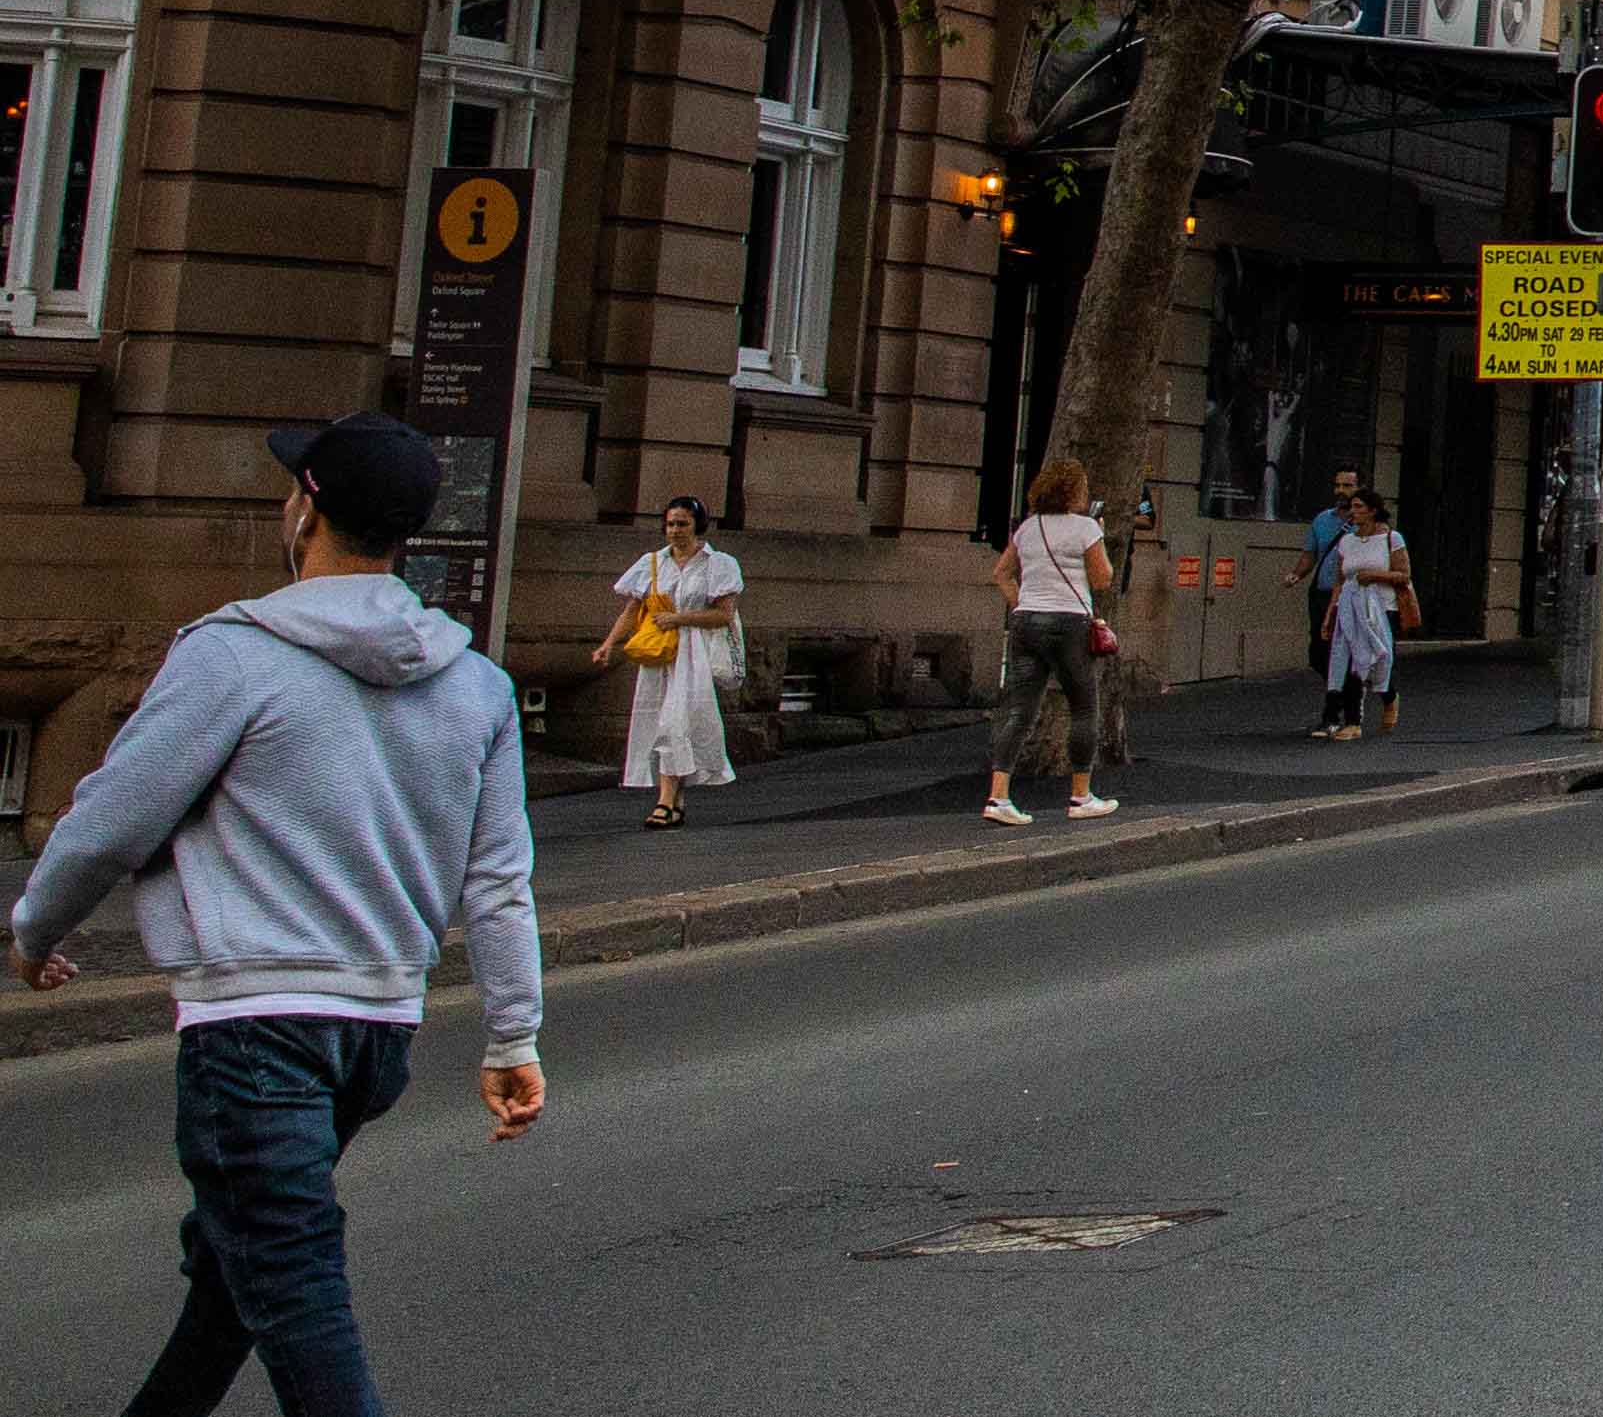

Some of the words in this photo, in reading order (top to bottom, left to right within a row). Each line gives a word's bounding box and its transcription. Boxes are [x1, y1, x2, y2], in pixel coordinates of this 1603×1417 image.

[1484, 250, 1553, 264] SPECIAL
[1513, 277, 1585, 294] ROAD
[1500, 300, 1597, 317] CLOSED
[1543, 327, 1565, 342] SAT
[1569, 327, 1584, 342] 29
[1540, 344, 1556, 358] TO
[1485, 354, 1520, 374] 4AM
[1527, 359, 1557, 374] SUN
[1563, 360, 1570, 373] 1
